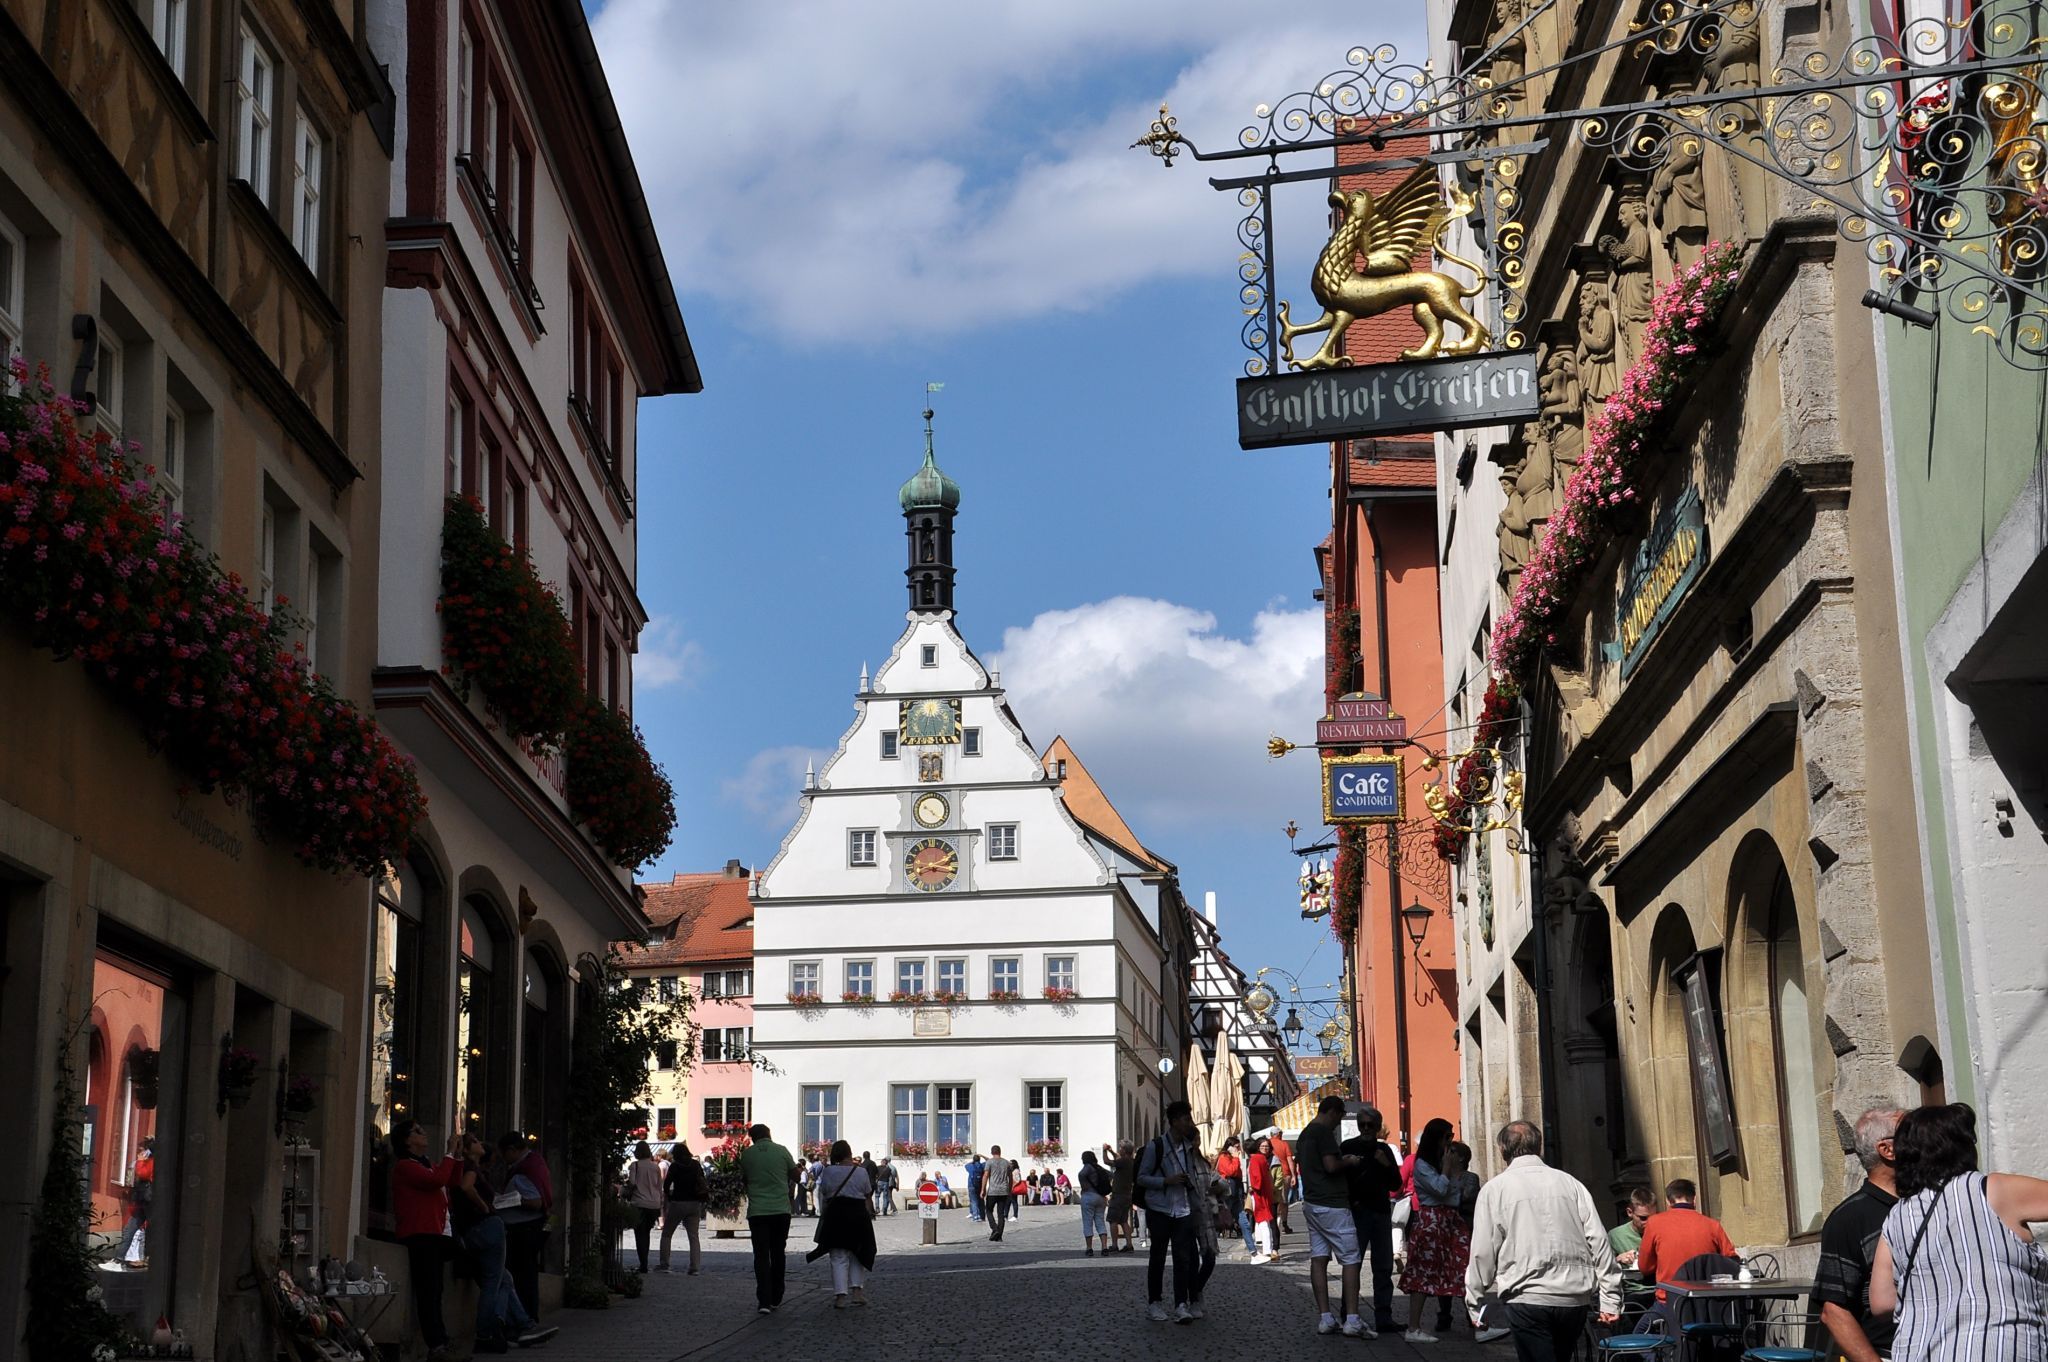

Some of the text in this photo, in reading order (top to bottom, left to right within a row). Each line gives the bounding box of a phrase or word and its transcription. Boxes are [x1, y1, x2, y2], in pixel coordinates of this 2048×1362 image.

[1245, 360, 1531, 429] Gasthof Greifen
[1339, 703, 1383, 717] WEIN
[1320, 723, 1405, 738] RESTAURANT
[1339, 773, 1389, 795] Cafe
[1336, 795, 1393, 807] CONDITOREI
